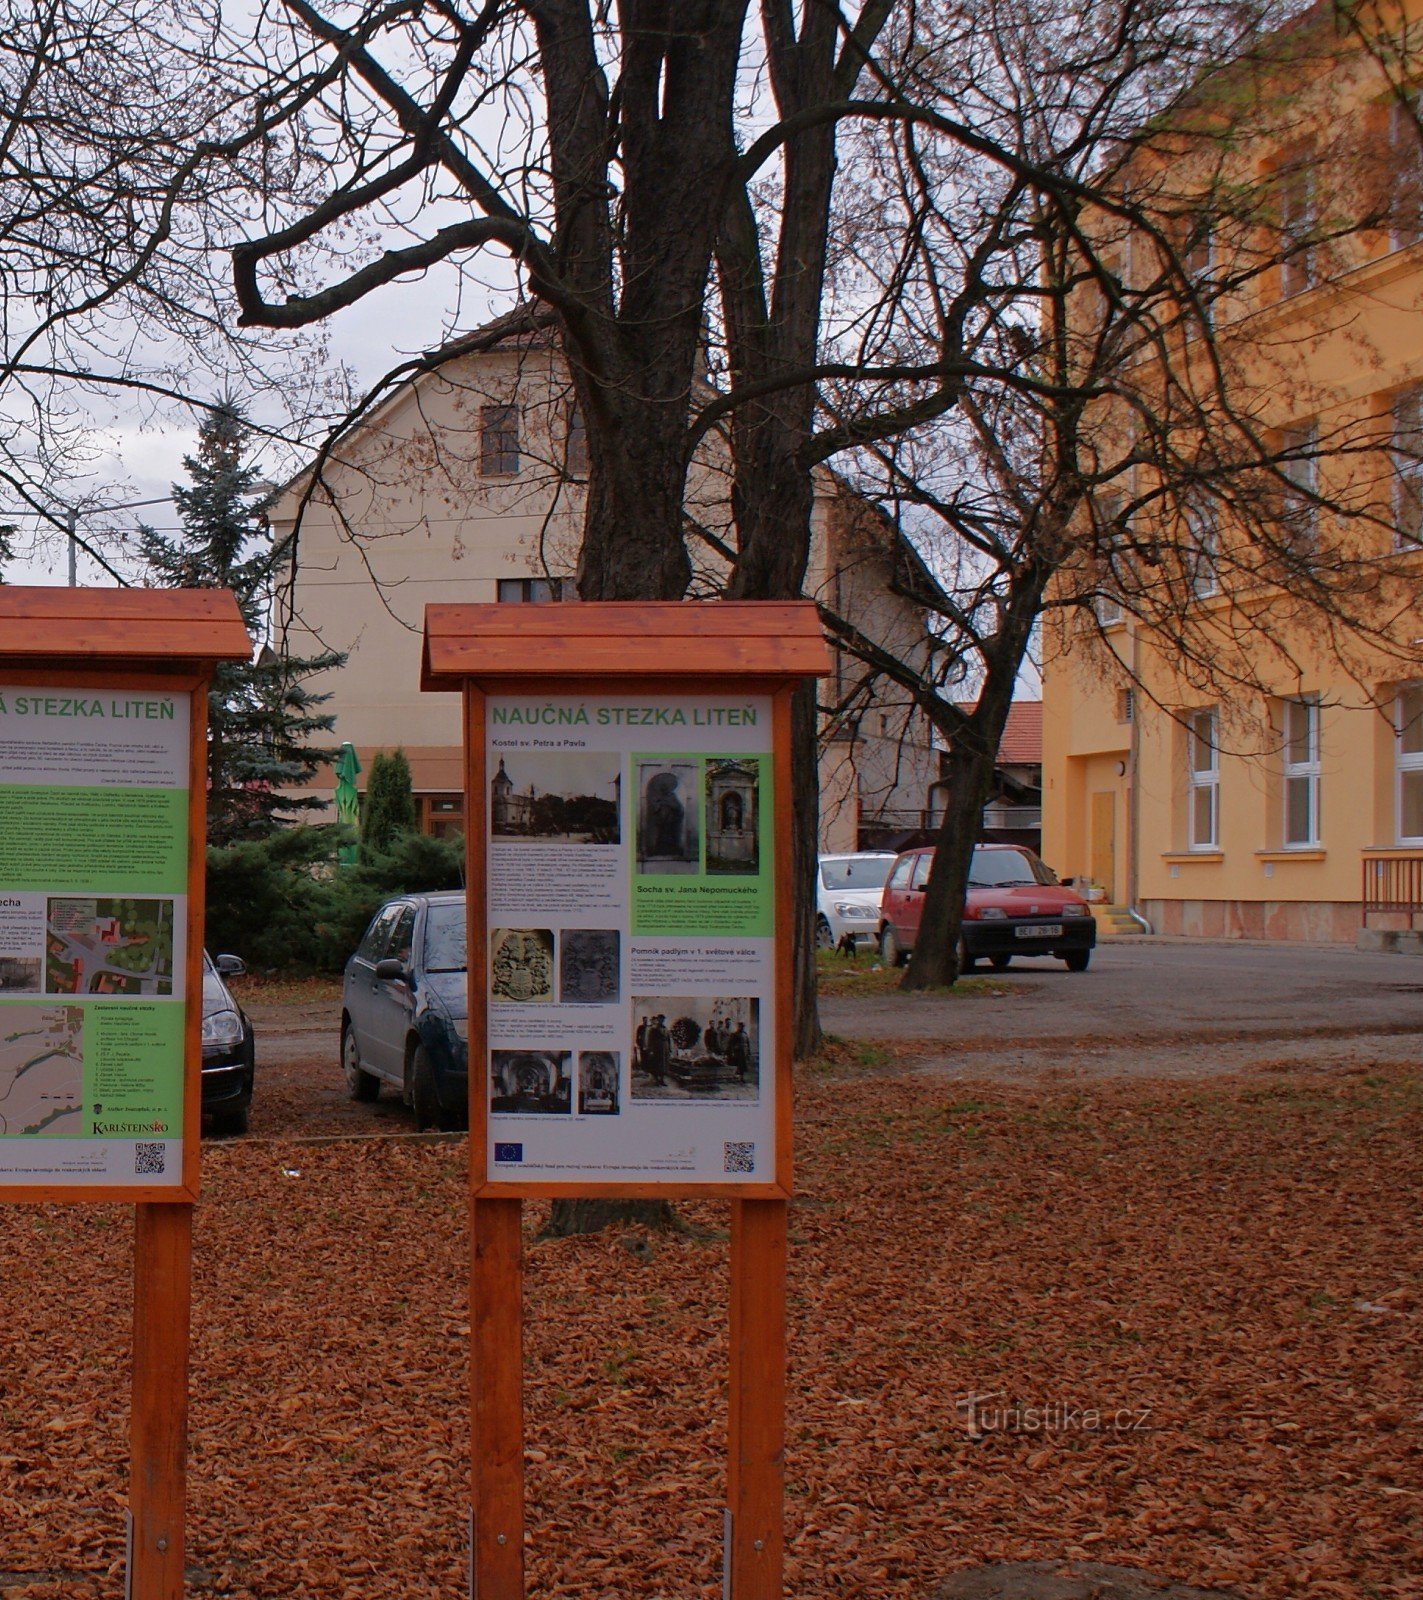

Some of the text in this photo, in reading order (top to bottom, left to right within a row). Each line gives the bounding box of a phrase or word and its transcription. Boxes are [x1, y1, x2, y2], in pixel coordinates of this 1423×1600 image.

[15, 698, 104, 718] STEZKA
[111, 697, 175, 720] LITEŇ
[492, 703, 758, 726] NAUČNÁ STEZKA LITEŇ
[492, 739, 518, 747] Kostel
[533, 739, 554, 747] Petra
[563, 739, 586, 747] Pavla
[637, 885, 663, 895] Socha
[678, 886, 697, 895] Jana
[699, 885, 758, 896] Nepomuckého
[631, 947, 659, 956] Pomník
[662, 947, 688, 957] padlým
[698, 947, 705, 956] 1.
